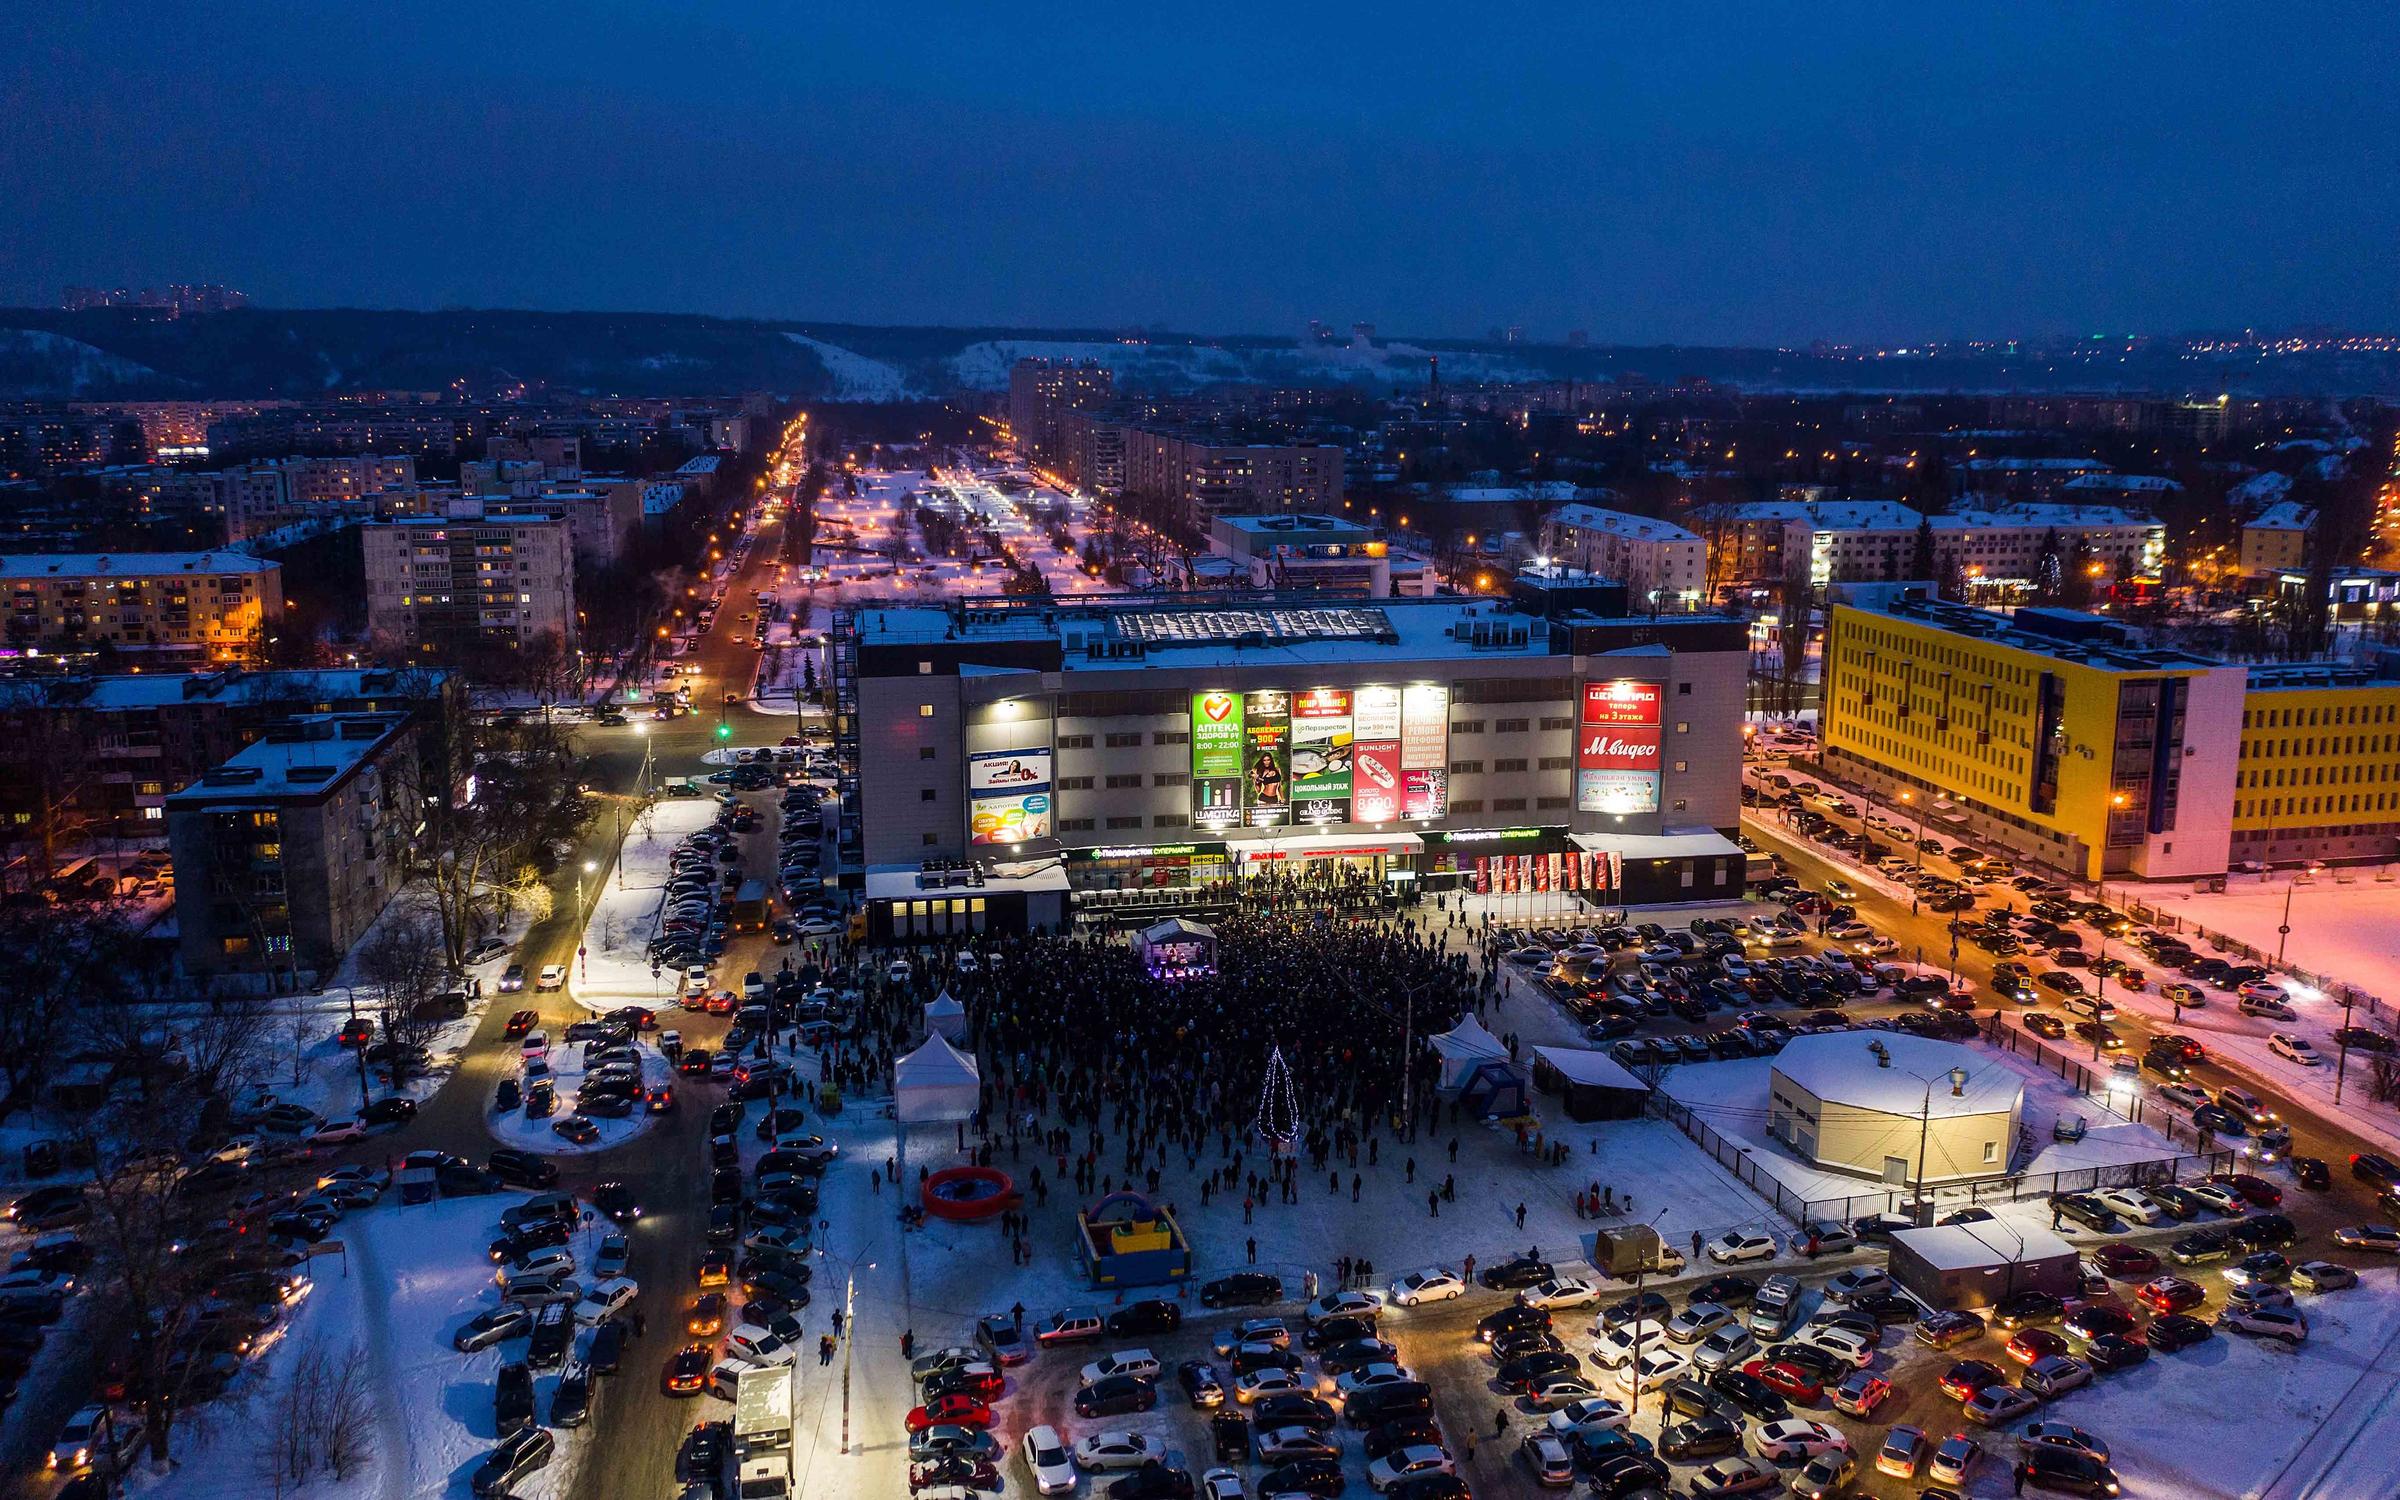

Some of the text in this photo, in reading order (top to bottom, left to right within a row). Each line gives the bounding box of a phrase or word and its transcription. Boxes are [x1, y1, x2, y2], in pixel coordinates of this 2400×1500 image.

[1611, 711, 1618, 719] 3
[1197, 723, 1239, 733] АПТЕКА
[1408, 725, 1441, 735] РЕМОНТ
[1257, 735, 1274, 743] 900
[1403, 735, 1445, 745] ТЕЛЕФОНОВ
[1583, 736, 1657, 760] М.видео
[1294, 783, 1332, 793] ЦОКОЛЬНЫЙ
[1195, 810, 1240, 819] ШМОТКА
[1501, 830, 1540, 838] СУПЕРМАРКЕТ
[1153, 846, 1196, 855] СУПЕРМАРКЕТ
